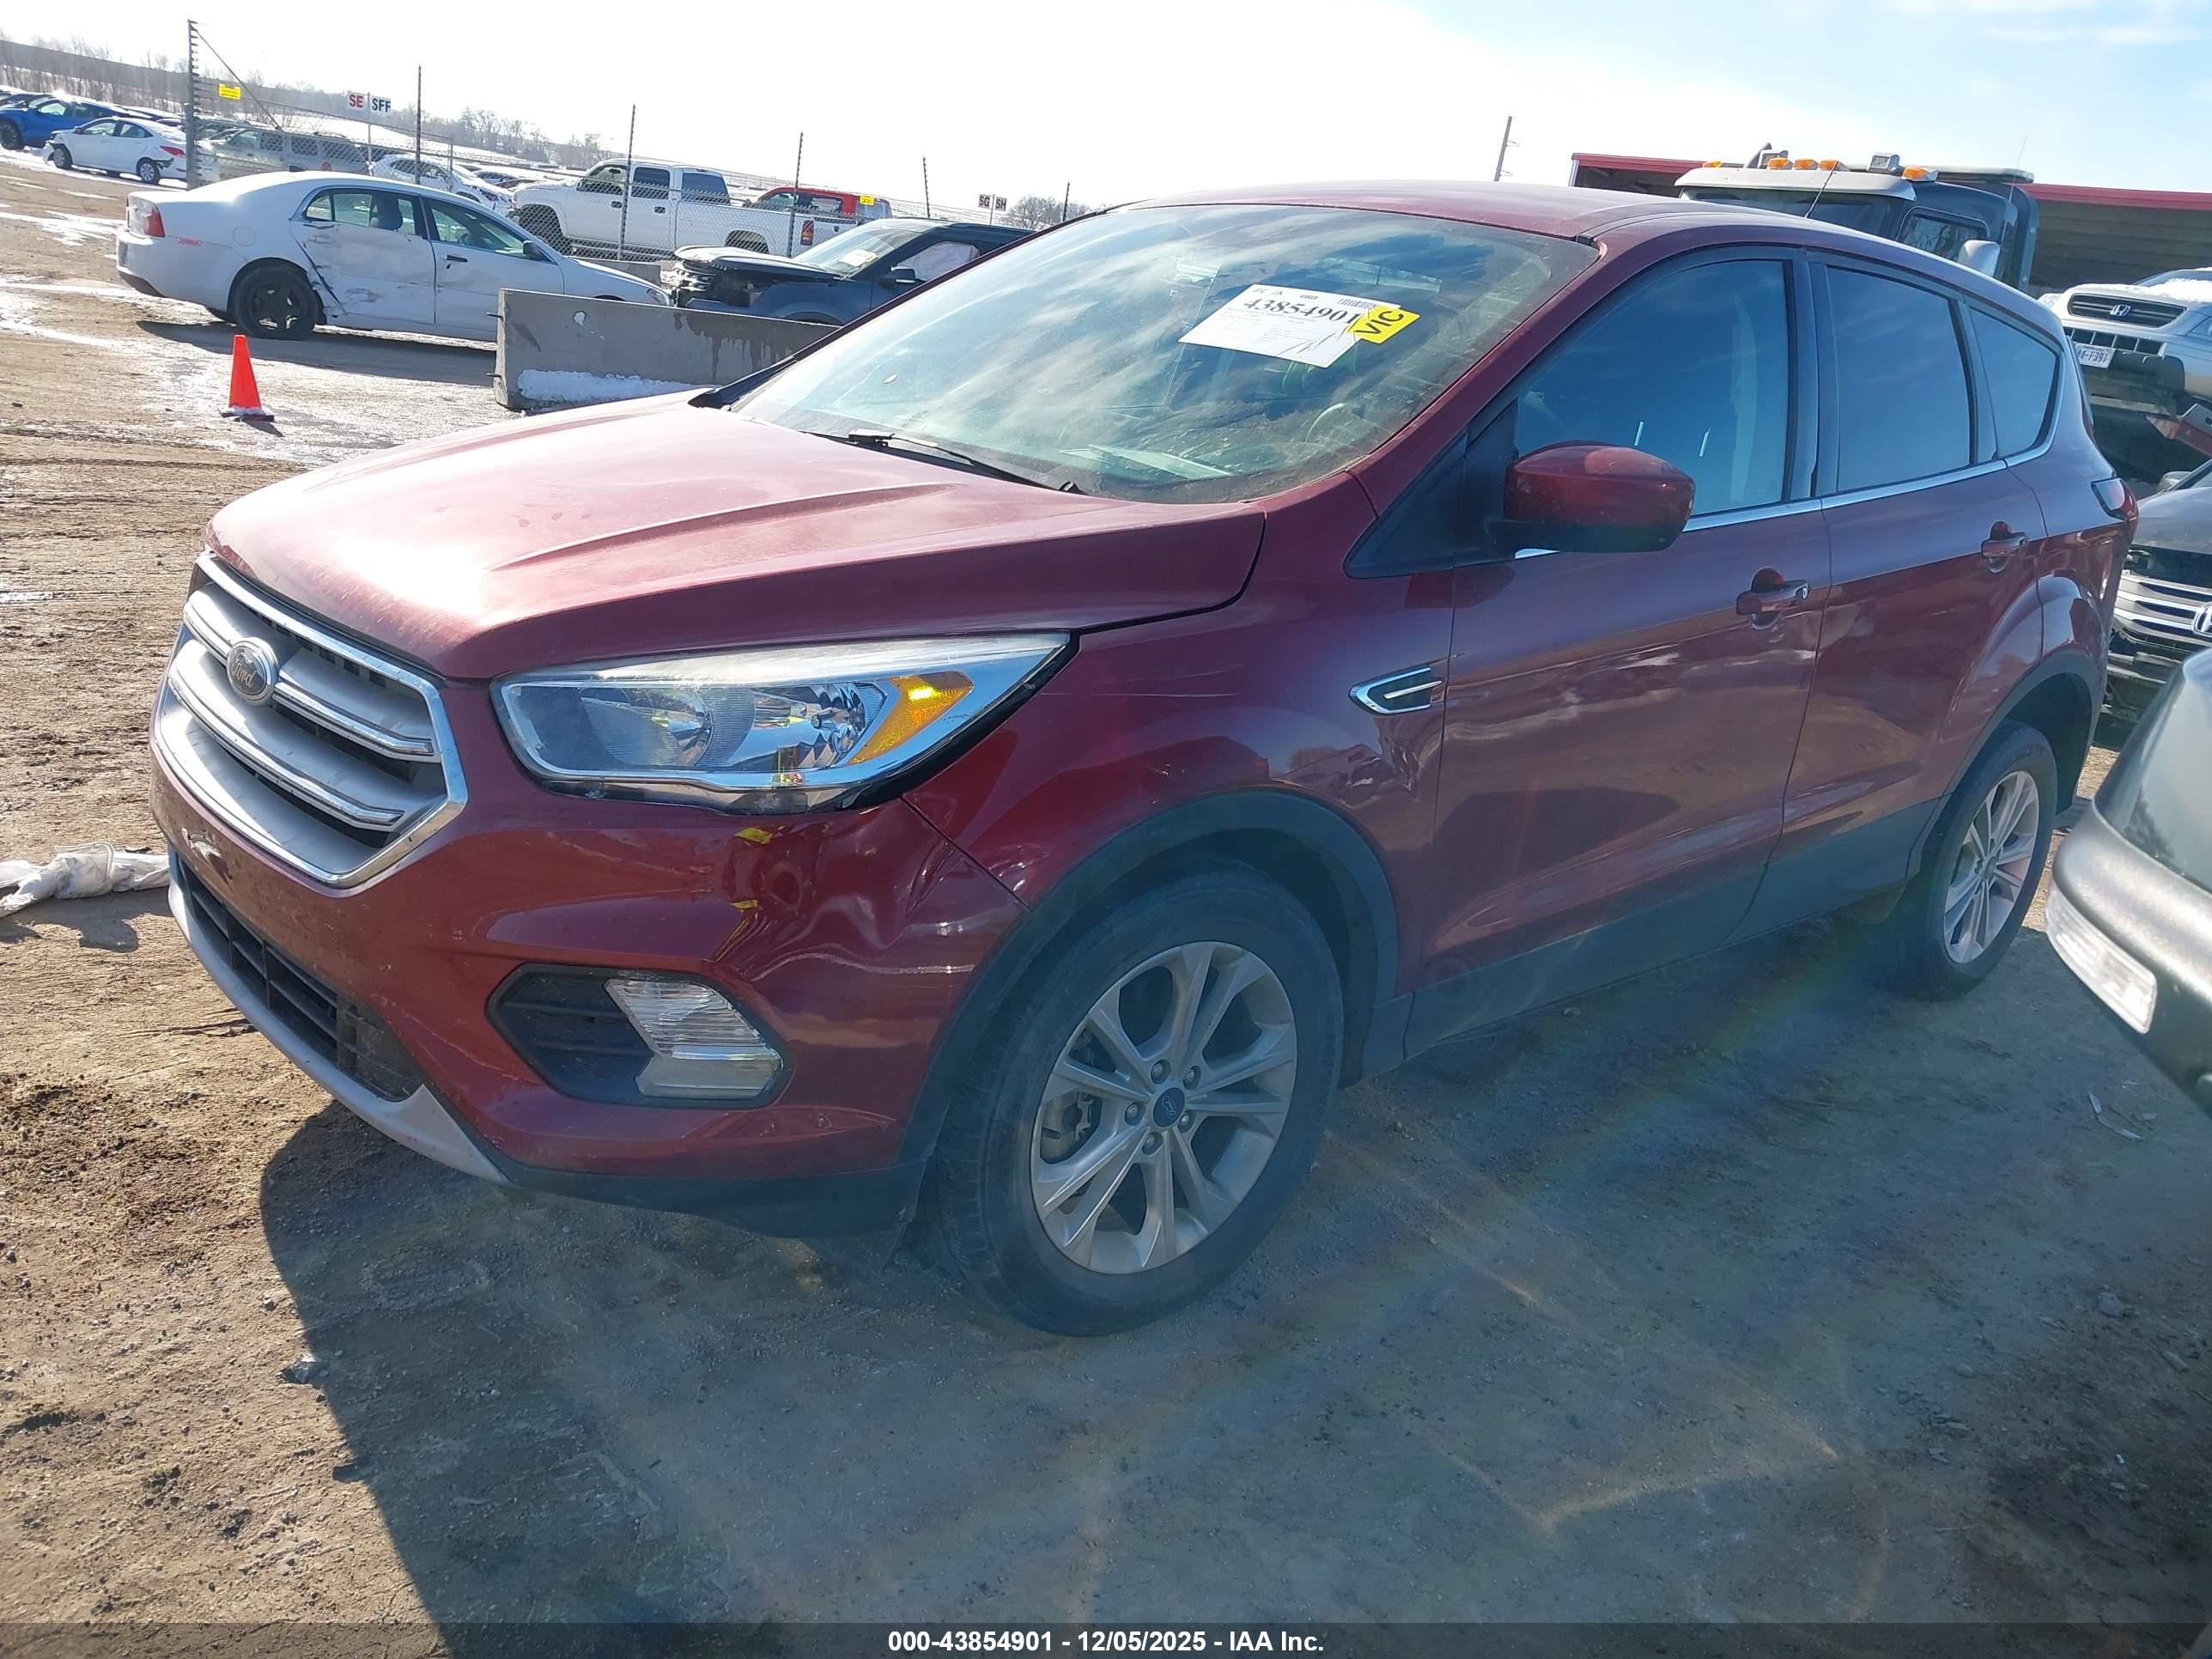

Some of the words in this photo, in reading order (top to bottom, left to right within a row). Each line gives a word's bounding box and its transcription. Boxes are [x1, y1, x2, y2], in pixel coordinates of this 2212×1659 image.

[349, 94, 364, 108] SE
[371, 97, 392, 112] SFF
[979, 196, 990, 207] SG
[995, 198, 1007, 211] SH
[1243, 298, 1361, 325] 43854901
[1353, 310, 1406, 335] VIC
[231, 652, 258, 688] Ford
